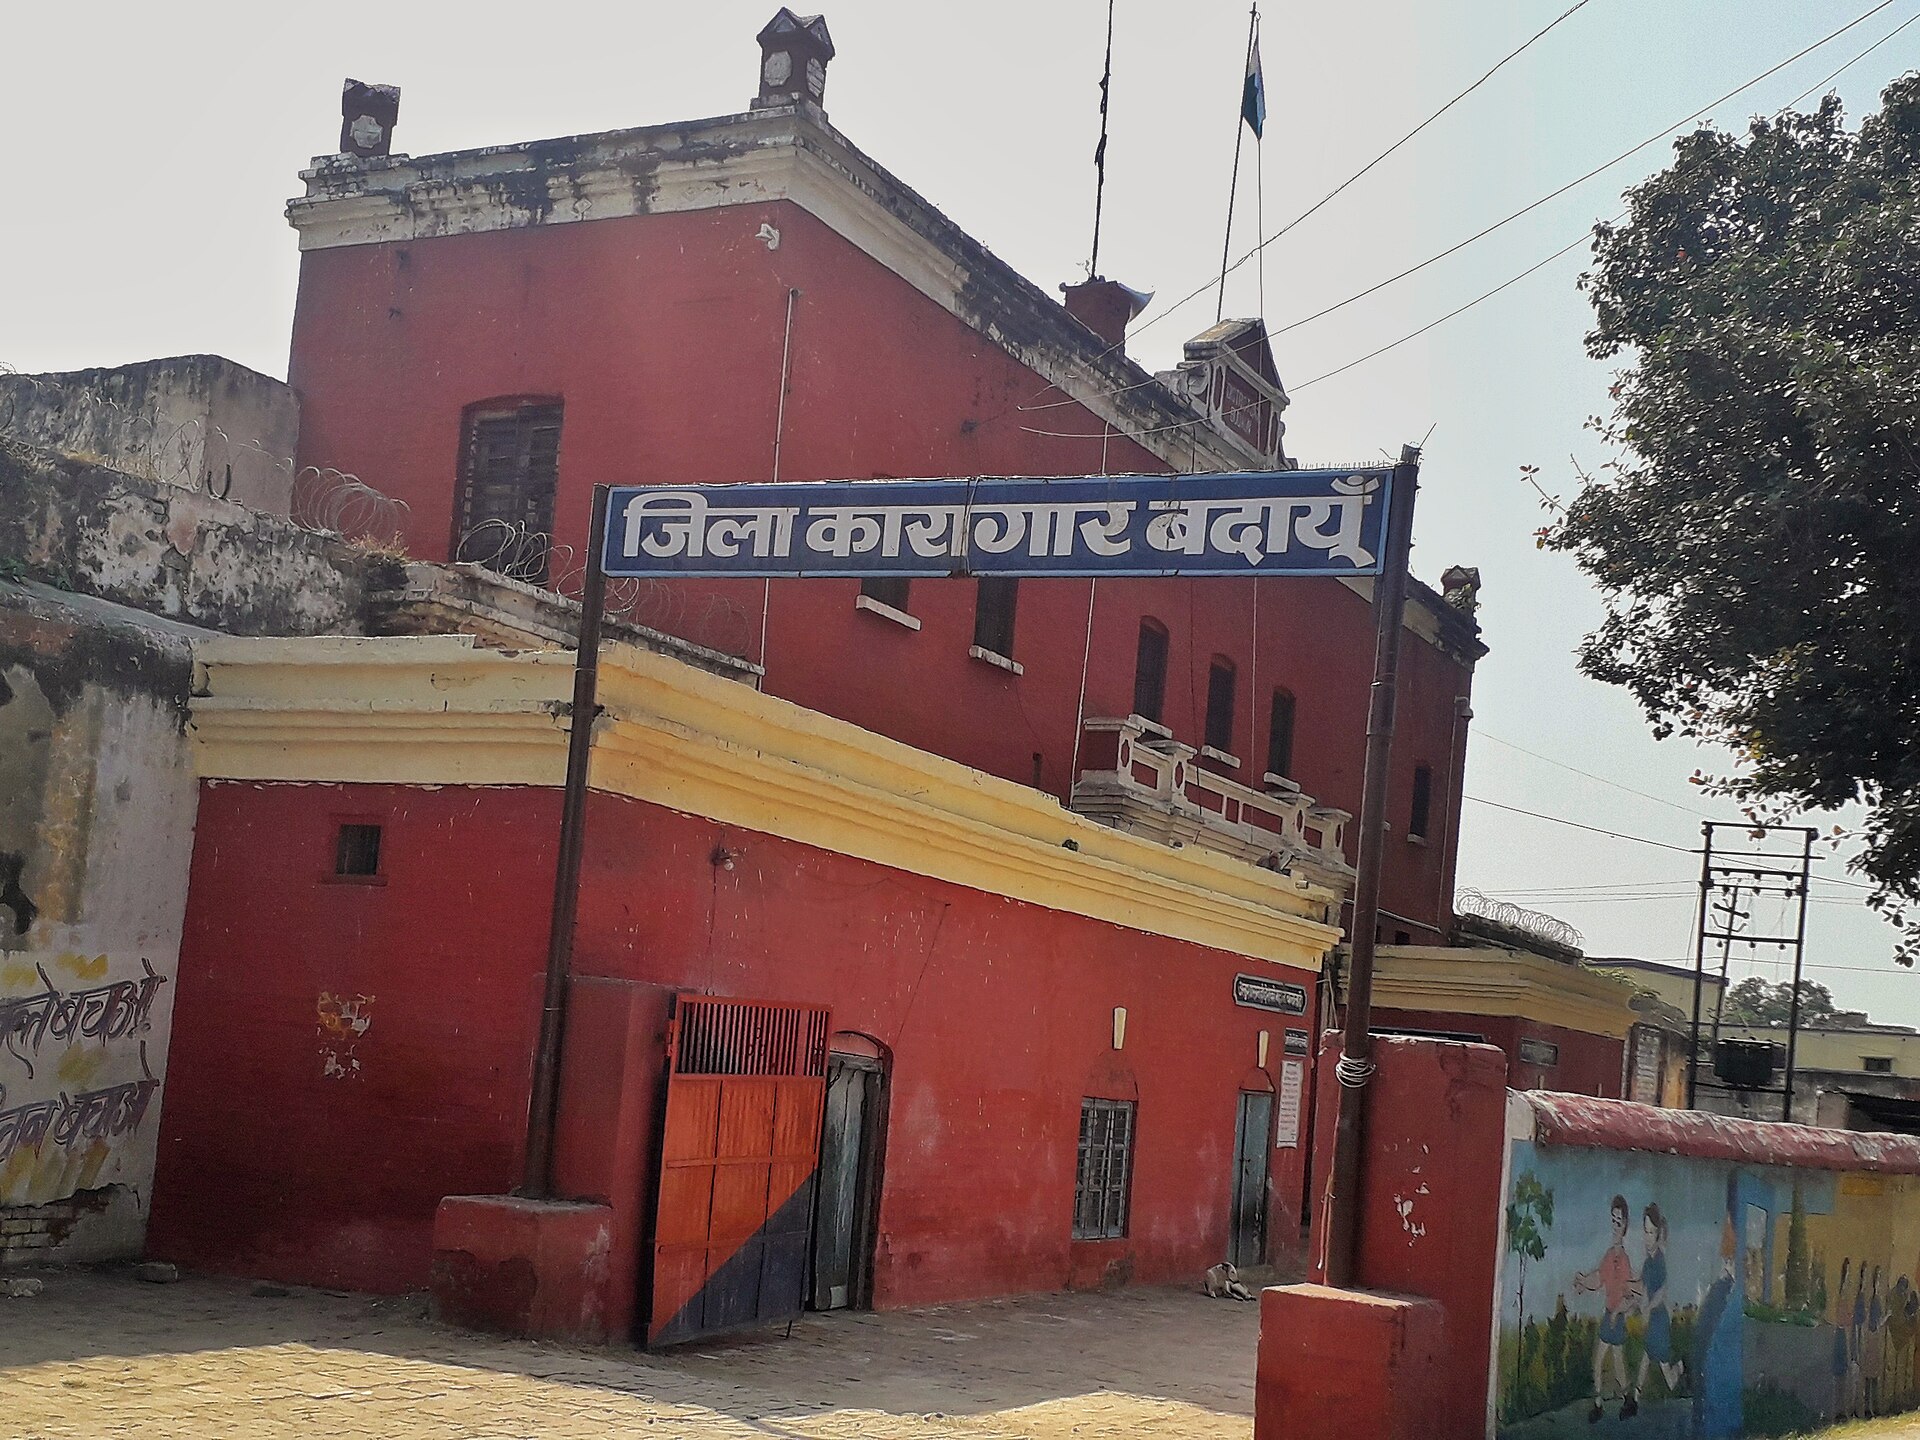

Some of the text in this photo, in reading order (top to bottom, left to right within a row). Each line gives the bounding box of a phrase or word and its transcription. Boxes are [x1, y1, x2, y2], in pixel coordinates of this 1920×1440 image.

[622, 475, 1381, 568] जिला कारागार बदायूँ
